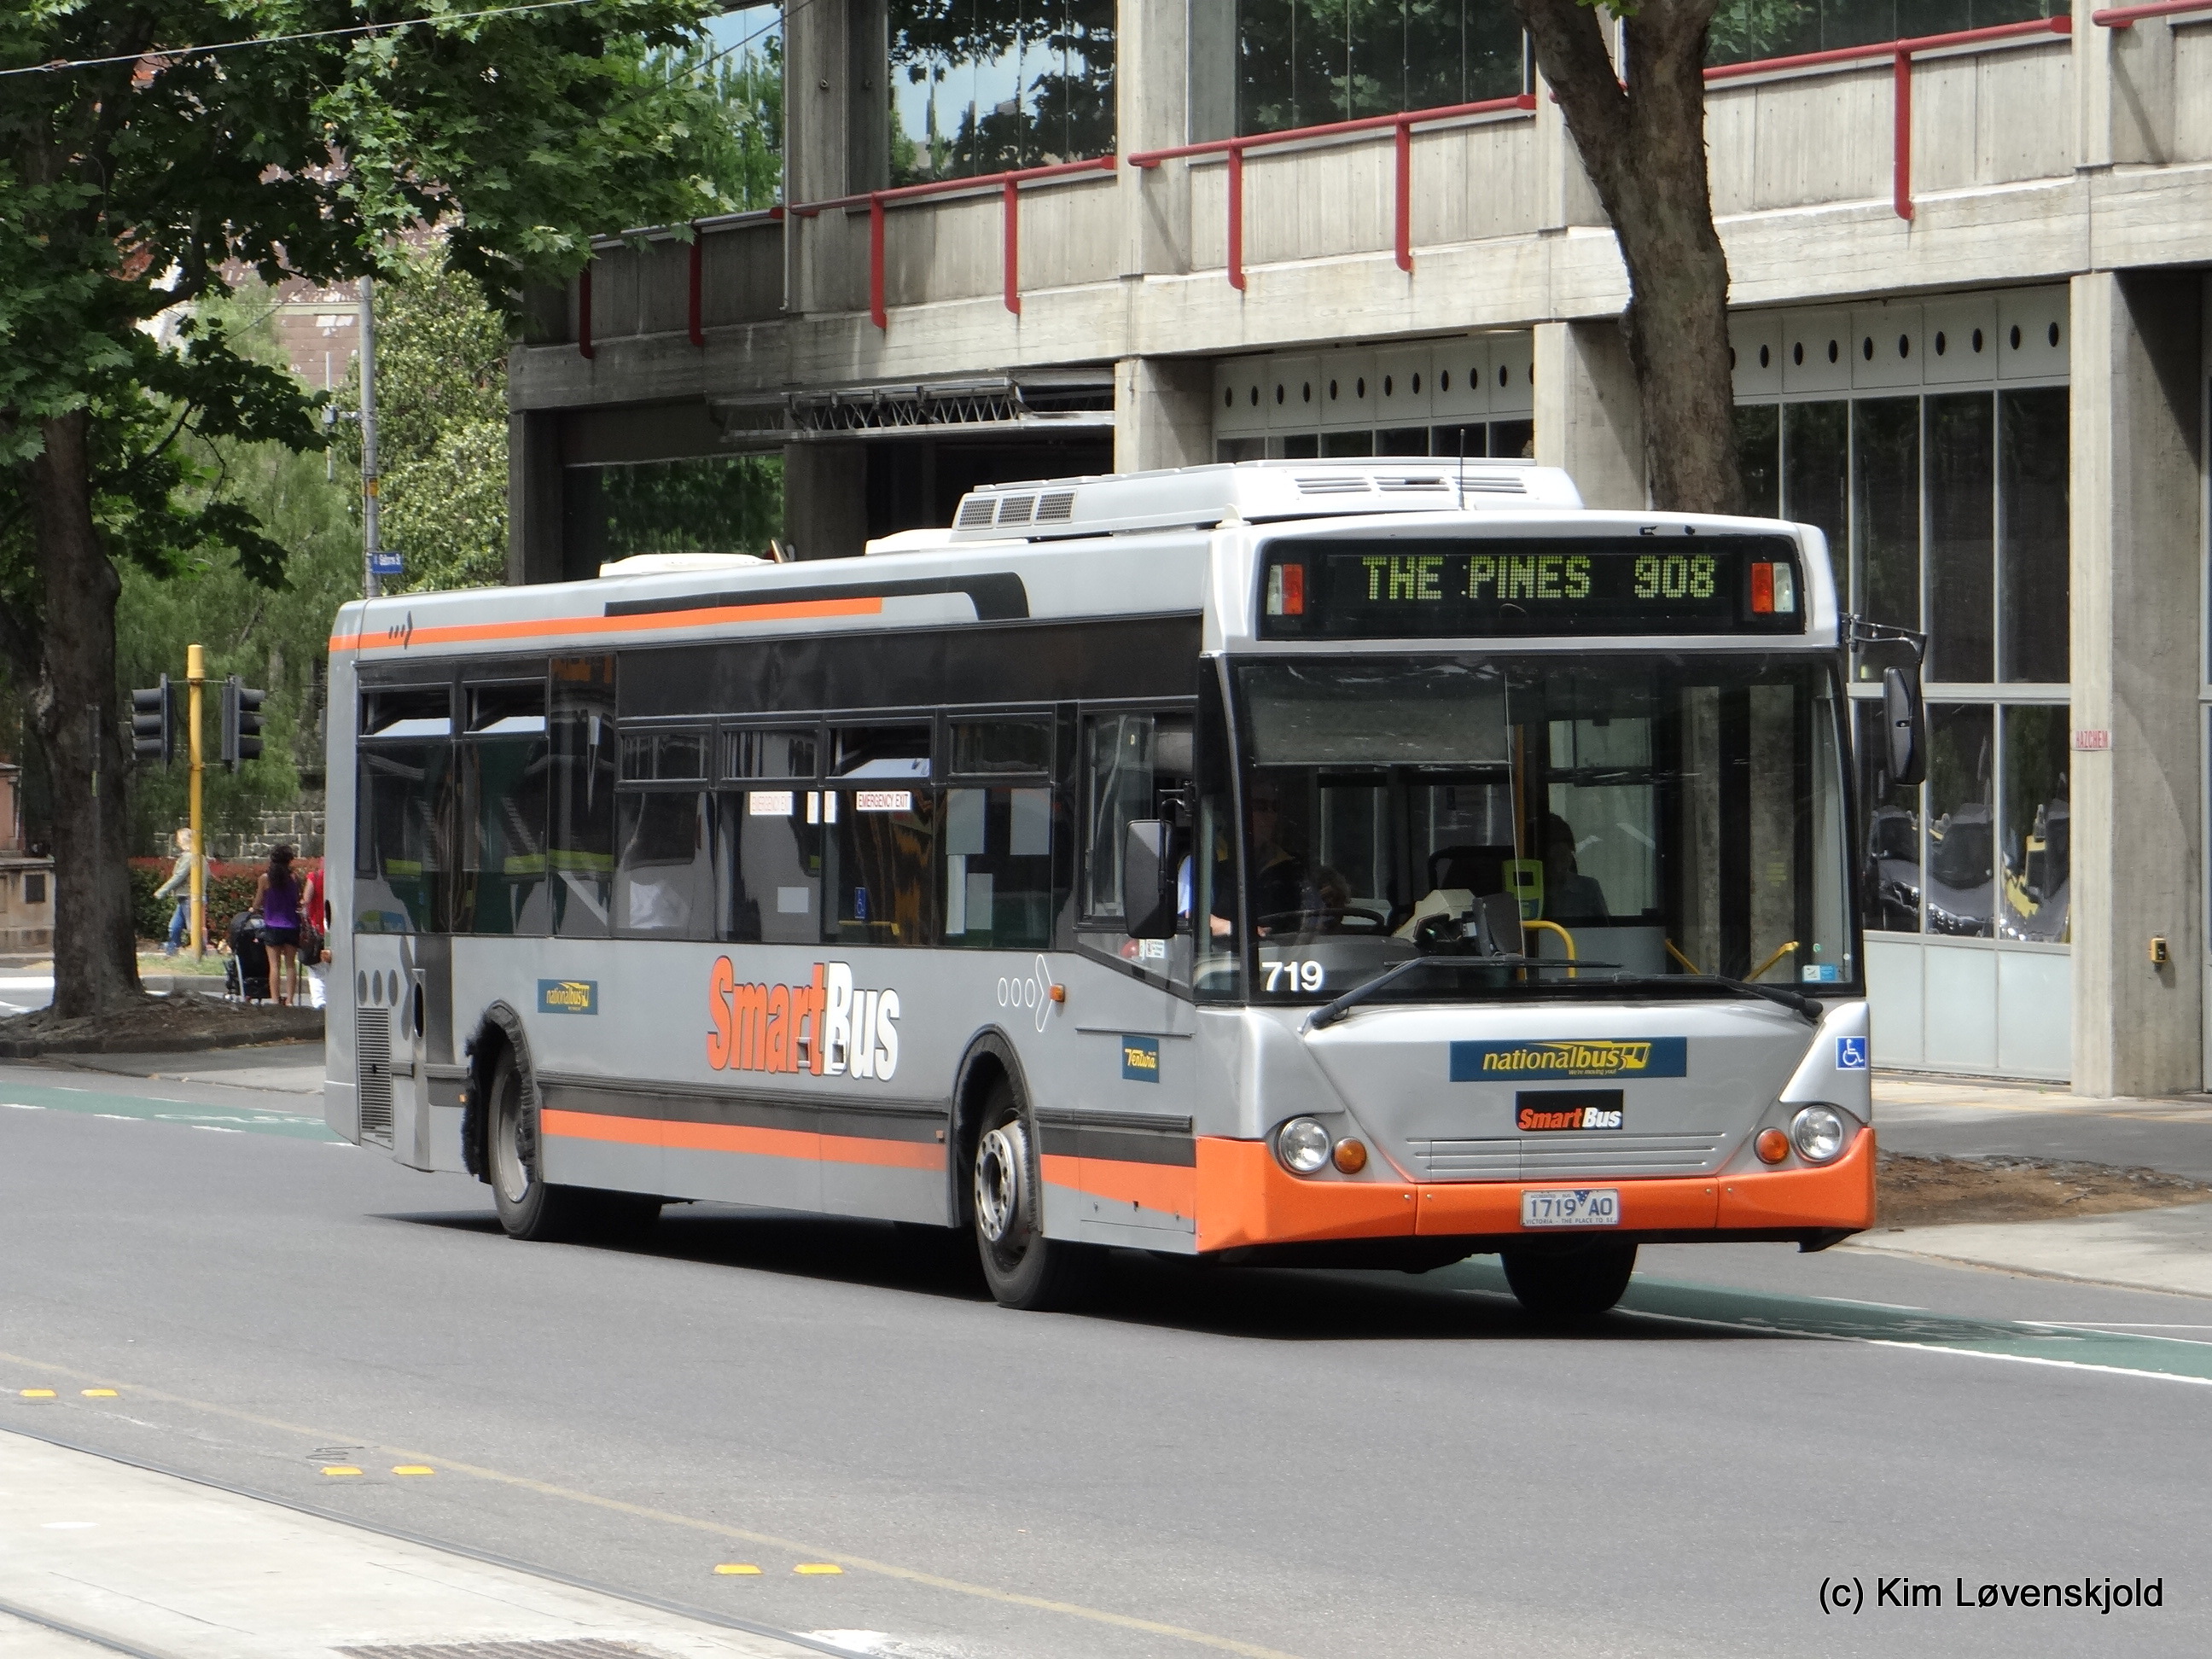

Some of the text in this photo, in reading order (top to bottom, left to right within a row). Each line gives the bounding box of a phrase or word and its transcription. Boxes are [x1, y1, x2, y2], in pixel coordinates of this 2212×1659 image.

[1363, 555, 1715, 599] THE PINES 908
[859, 794, 908, 807] EMERGENCY EXIT
[1261, 960, 1324, 992] 719
[1124, 1048, 1156, 1068] Ventura
[1482, 1045, 1621, 1071] nationalbus
[1531, 1198, 1577, 1218] 1719
